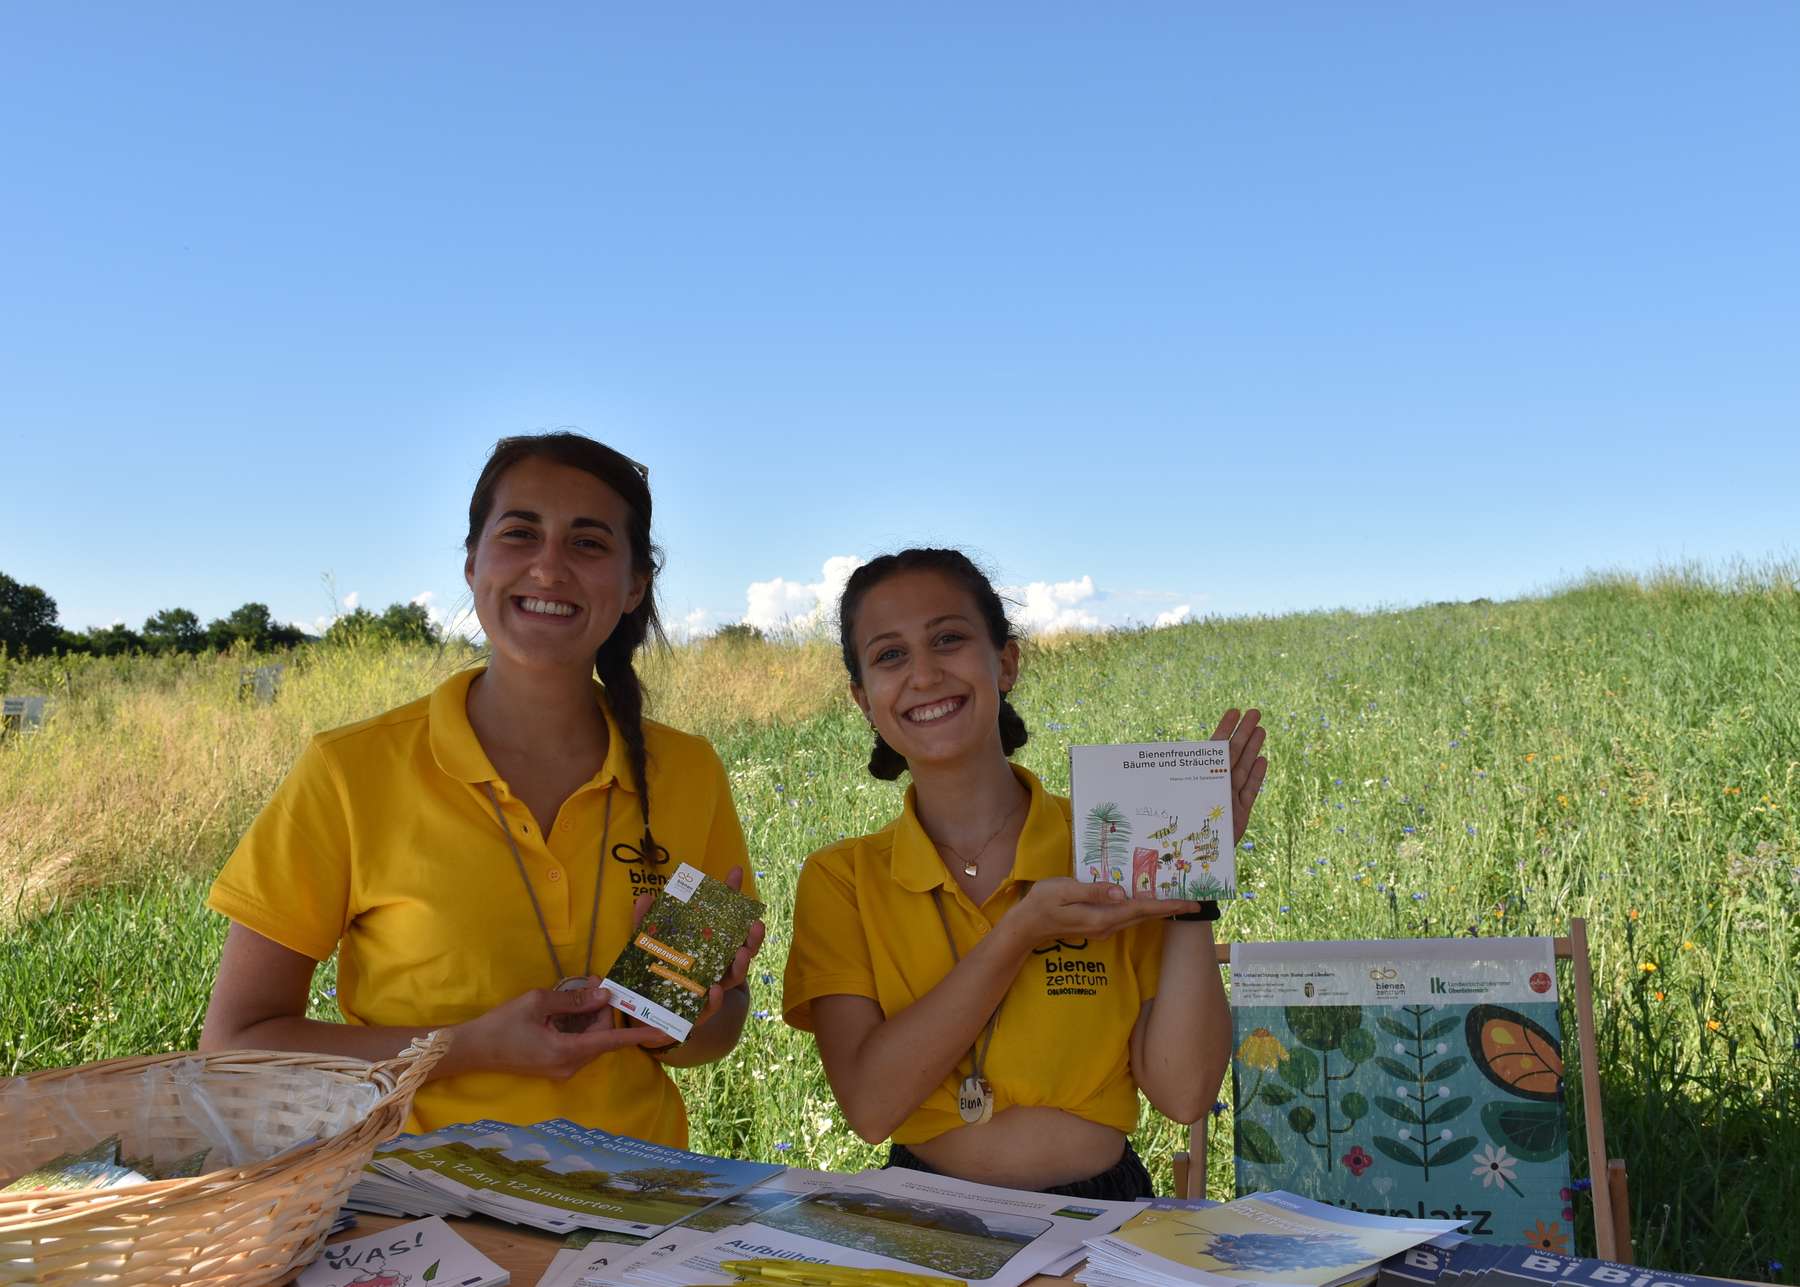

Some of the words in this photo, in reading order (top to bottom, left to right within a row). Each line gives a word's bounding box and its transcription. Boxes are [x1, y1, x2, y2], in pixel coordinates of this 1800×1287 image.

[1138, 748, 1224, 759] Bienenfreundliche
[1123, 760, 1156, 769] Bäume
[1159, 759, 1176, 768] und
[1179, 757, 1224, 767] Sträucher
[629, 868, 667, 885] bien
[640, 936, 690, 967] Bienenweide
[1046, 956, 1106, 973] bienen
[1046, 973, 1108, 986] zentrum
[602, 1142, 681, 1165] elemente
[453, 1162, 474, 1173] 12
[506, 1179, 529, 1190] 12
[527, 1186, 625, 1214] Antworten.
[724, 1239, 831, 1265] Aufblühen
